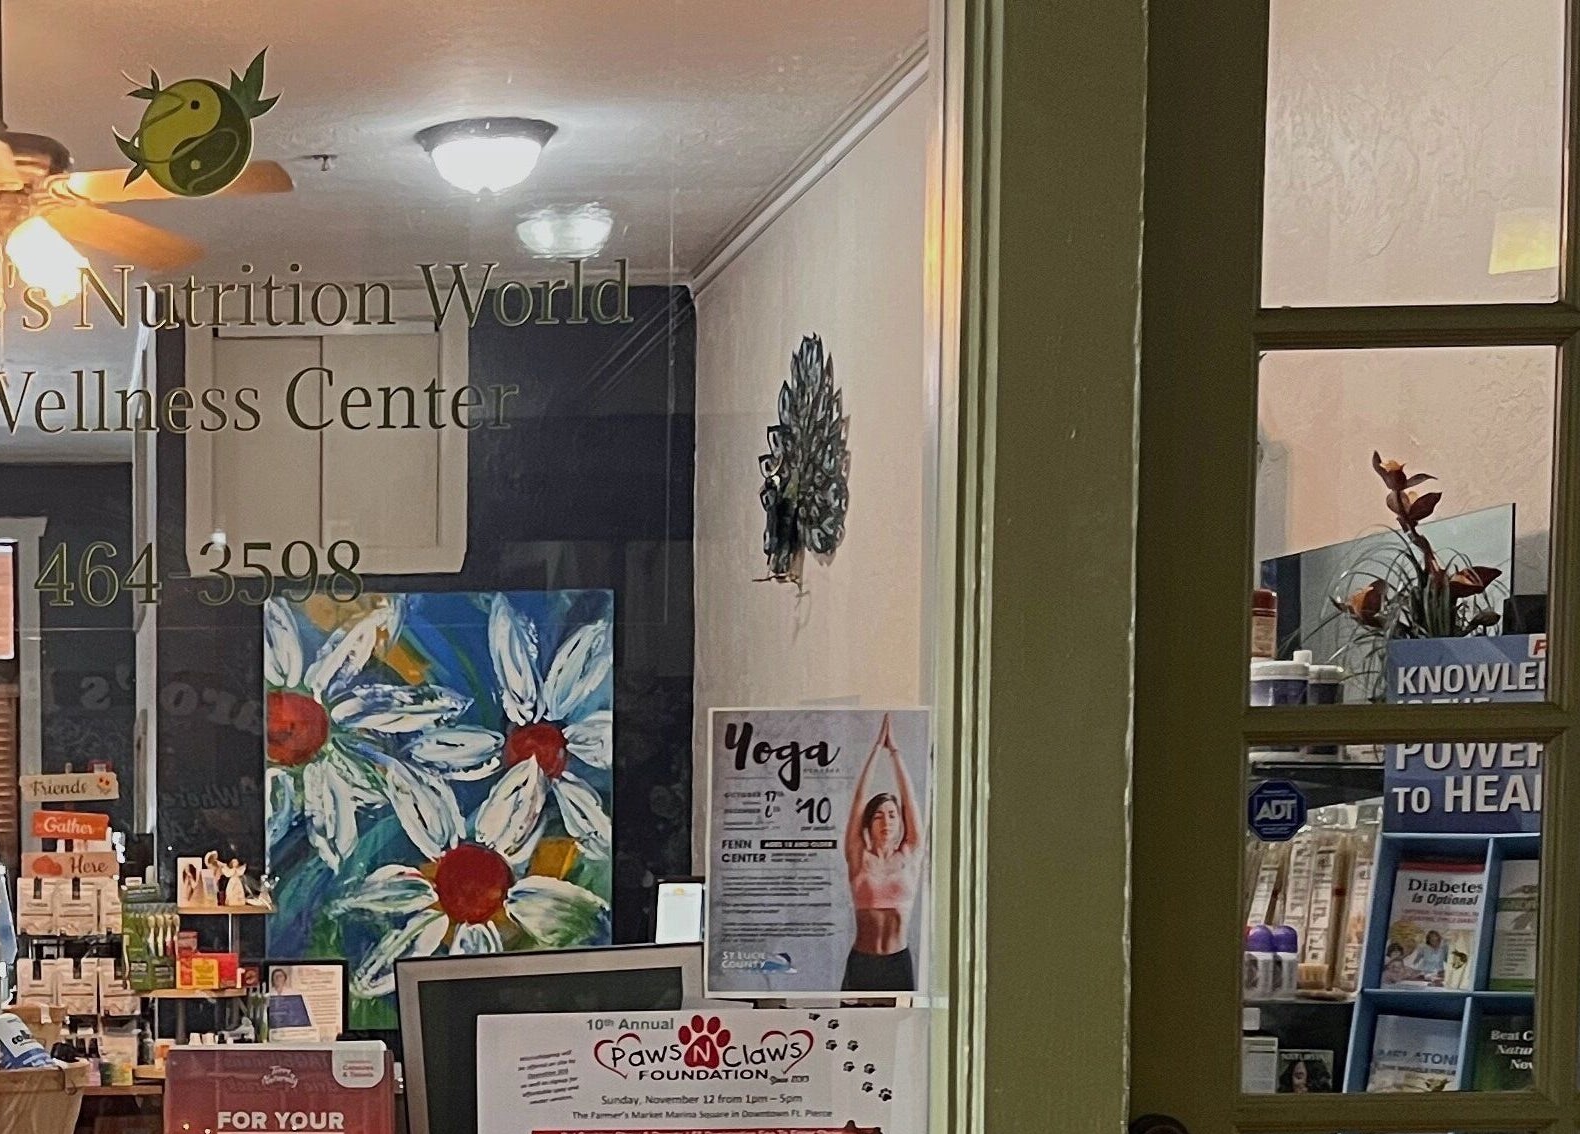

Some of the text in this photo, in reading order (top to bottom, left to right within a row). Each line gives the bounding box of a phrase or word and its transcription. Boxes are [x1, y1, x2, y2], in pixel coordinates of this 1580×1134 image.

[73, 264, 396, 330] Nutrition
[416, 258, 634, 328] World
[286, 367, 519, 431] Center
[33, 538, 363, 607] 464-3598
[1397, 661, 1546, 695] KNOWLE
[724, 722, 840, 791] Yoga
[32, 780, 87, 796] Friends
[1392, 787, 1431, 813] TO
[1255, 798, 1297, 822] ADT
[43, 817, 94, 835] Gather
[721, 840, 752, 849] FENN
[70, 856, 109, 873] Here
[721, 854, 766, 863] CENTER
[1408, 878, 1483, 894] Diabetes
[1427, 893, 1478, 906] Optional
[587, 1018, 674, 1030] 10th Annual
[612, 1041, 802, 1067] Paws N Claws
[638, 1069, 768, 1081] FOUNDATION
[601, 1094, 802, 1105] Sunday, November 12 from 1pm 5pm
[218, 1112, 344, 1130] FOR YOUR
